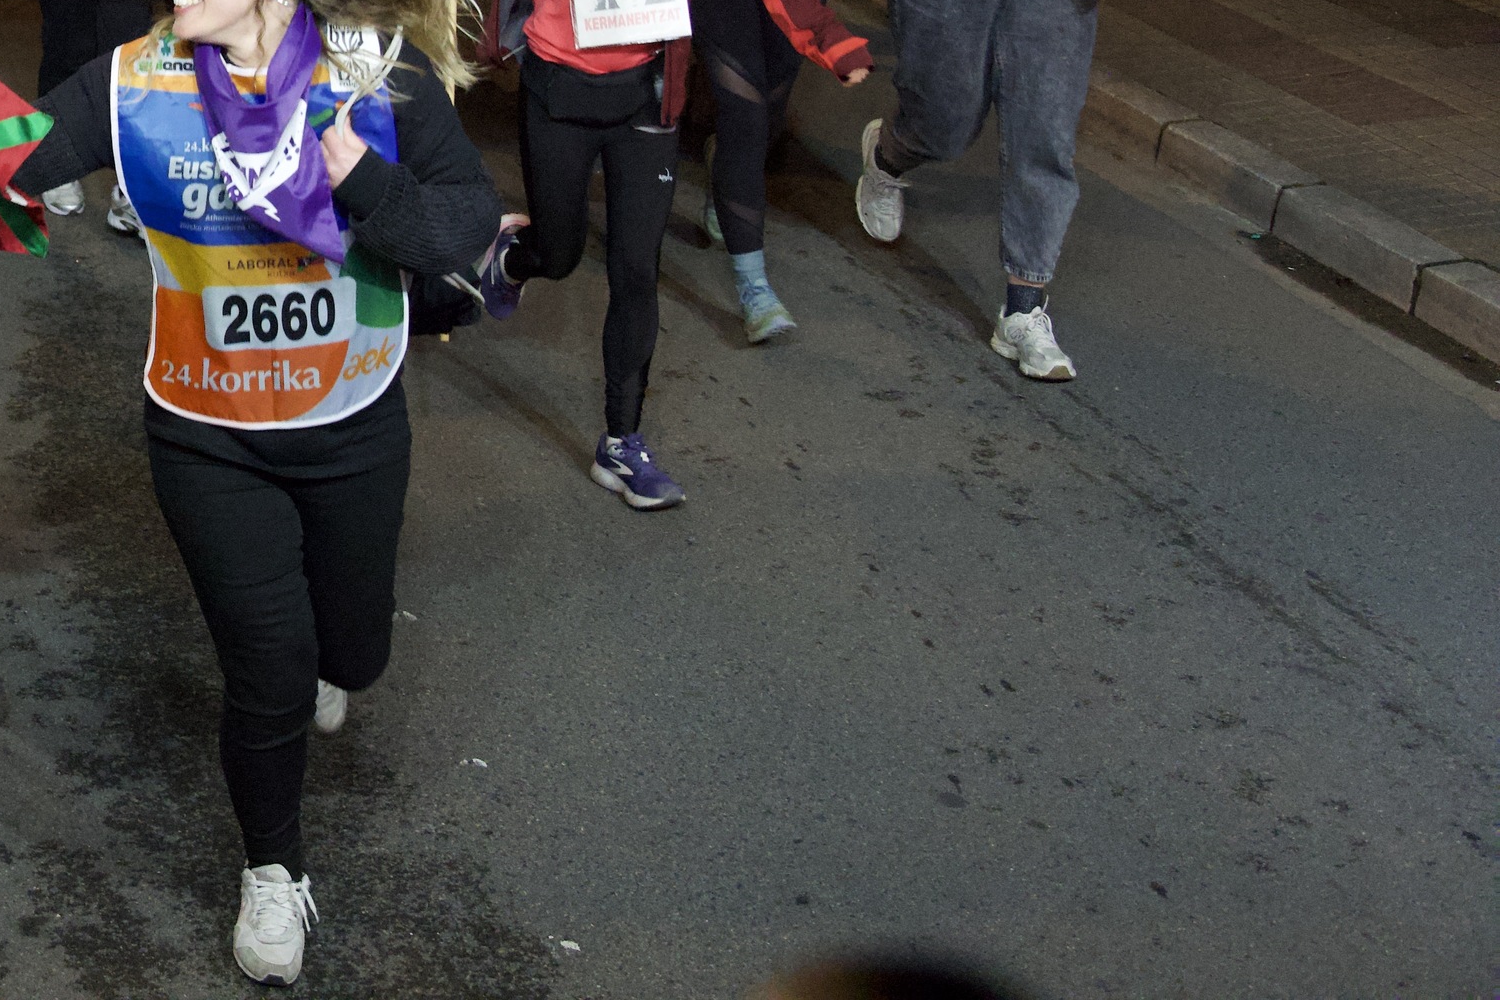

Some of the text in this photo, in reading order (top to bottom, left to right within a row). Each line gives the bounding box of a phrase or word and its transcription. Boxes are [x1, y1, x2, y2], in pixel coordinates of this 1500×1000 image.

[584, 6, 682, 33] KERMANENTZAT
[182, 182, 240, 221] ga
[227, 257, 294, 271] LABORAL
[222, 287, 336, 346] 2660
[161, 357, 322, 393] 24.korrika
[342, 336, 396, 382] aek
